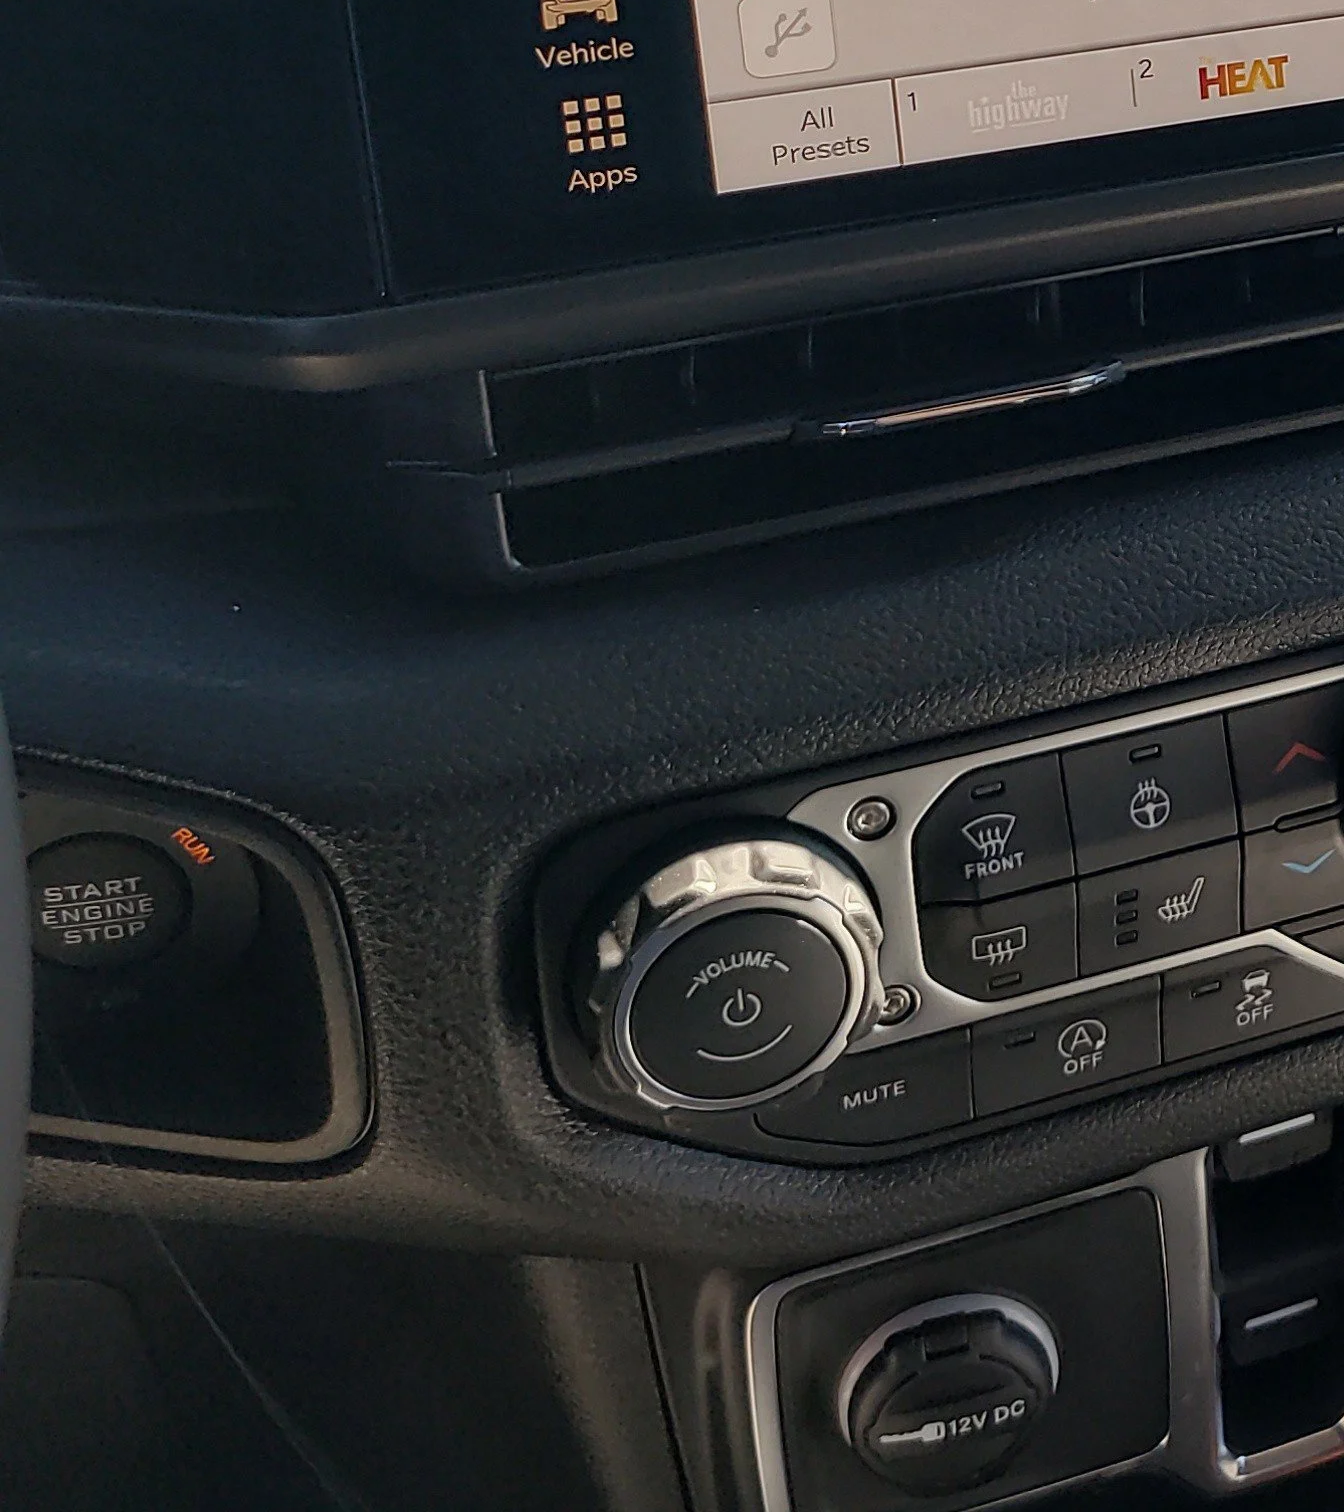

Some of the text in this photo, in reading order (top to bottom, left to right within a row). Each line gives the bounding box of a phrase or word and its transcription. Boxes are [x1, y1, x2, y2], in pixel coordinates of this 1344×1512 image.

[535, 37, 634, 69] Vehicle
[1139, 59, 1155, 80] 2
[1198, 54, 1289, 100] HEAT
[906, 91, 918, 112] 1
[967, 90, 1070, 131] highway
[800, 106, 834, 132] All
[772, 135, 871, 167] Presets
[568, 165, 638, 194] Apps
[170, 826, 216, 866] RUN
[964, 851, 1026, 880] FRONT
[43, 876, 142, 903] START
[42, 897, 155, 926] ENGINE
[63, 921, 146, 945] STOP
[693, 950, 776, 988] VOLUME
[1236, 1003, 1274, 1026] OFF
[1063, 1051, 1104, 1076] OFF
[843, 1079, 907, 1110] MUTE
[947, 1399, 1027, 1437] 12V DC
